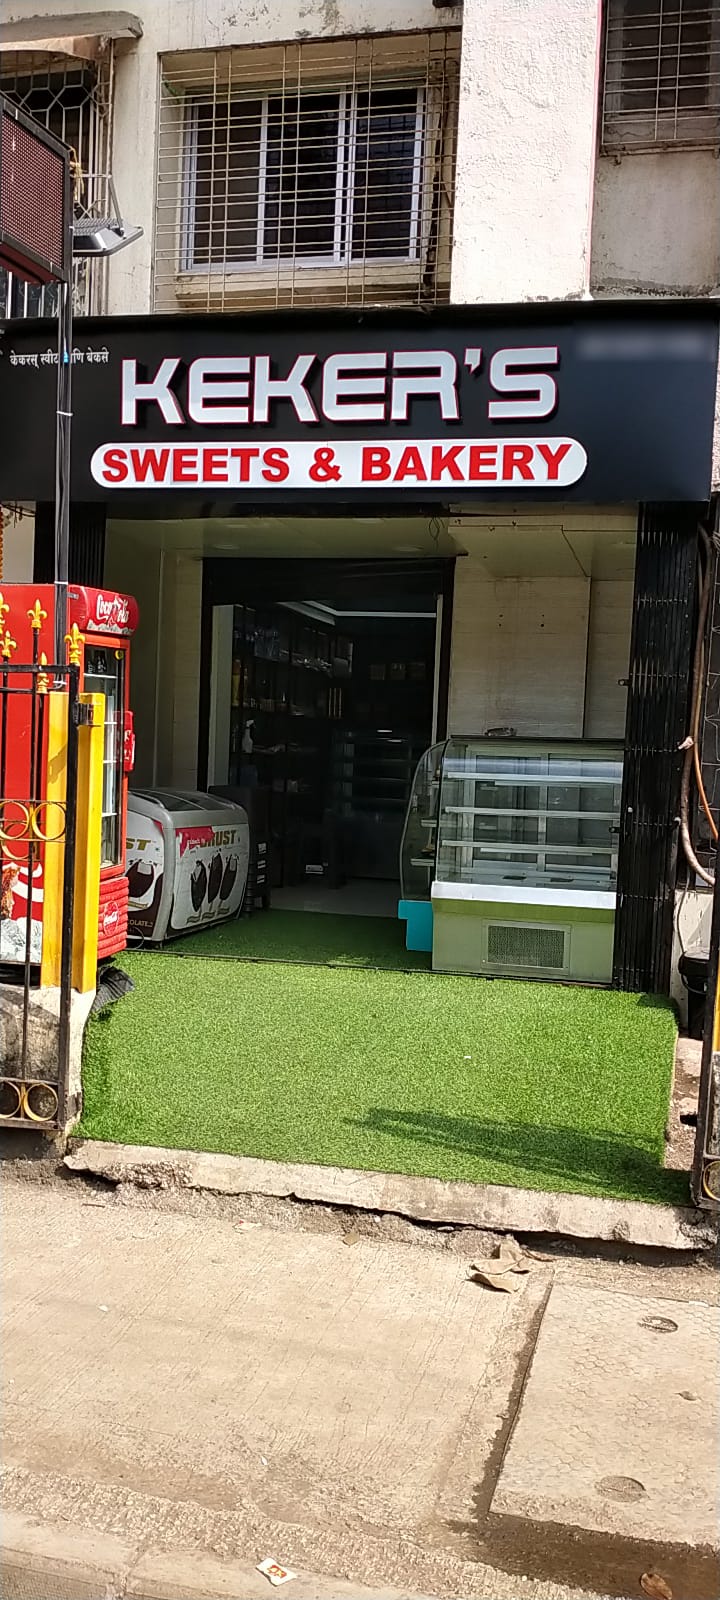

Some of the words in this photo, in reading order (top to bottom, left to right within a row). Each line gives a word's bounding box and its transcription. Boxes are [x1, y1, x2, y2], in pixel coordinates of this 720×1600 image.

[121, 346, 559, 426] KEKER'S
[101, 447, 290, 483] SWEETS
[308, 446, 342, 482] &
[361, 443, 572, 482] BAKERY
